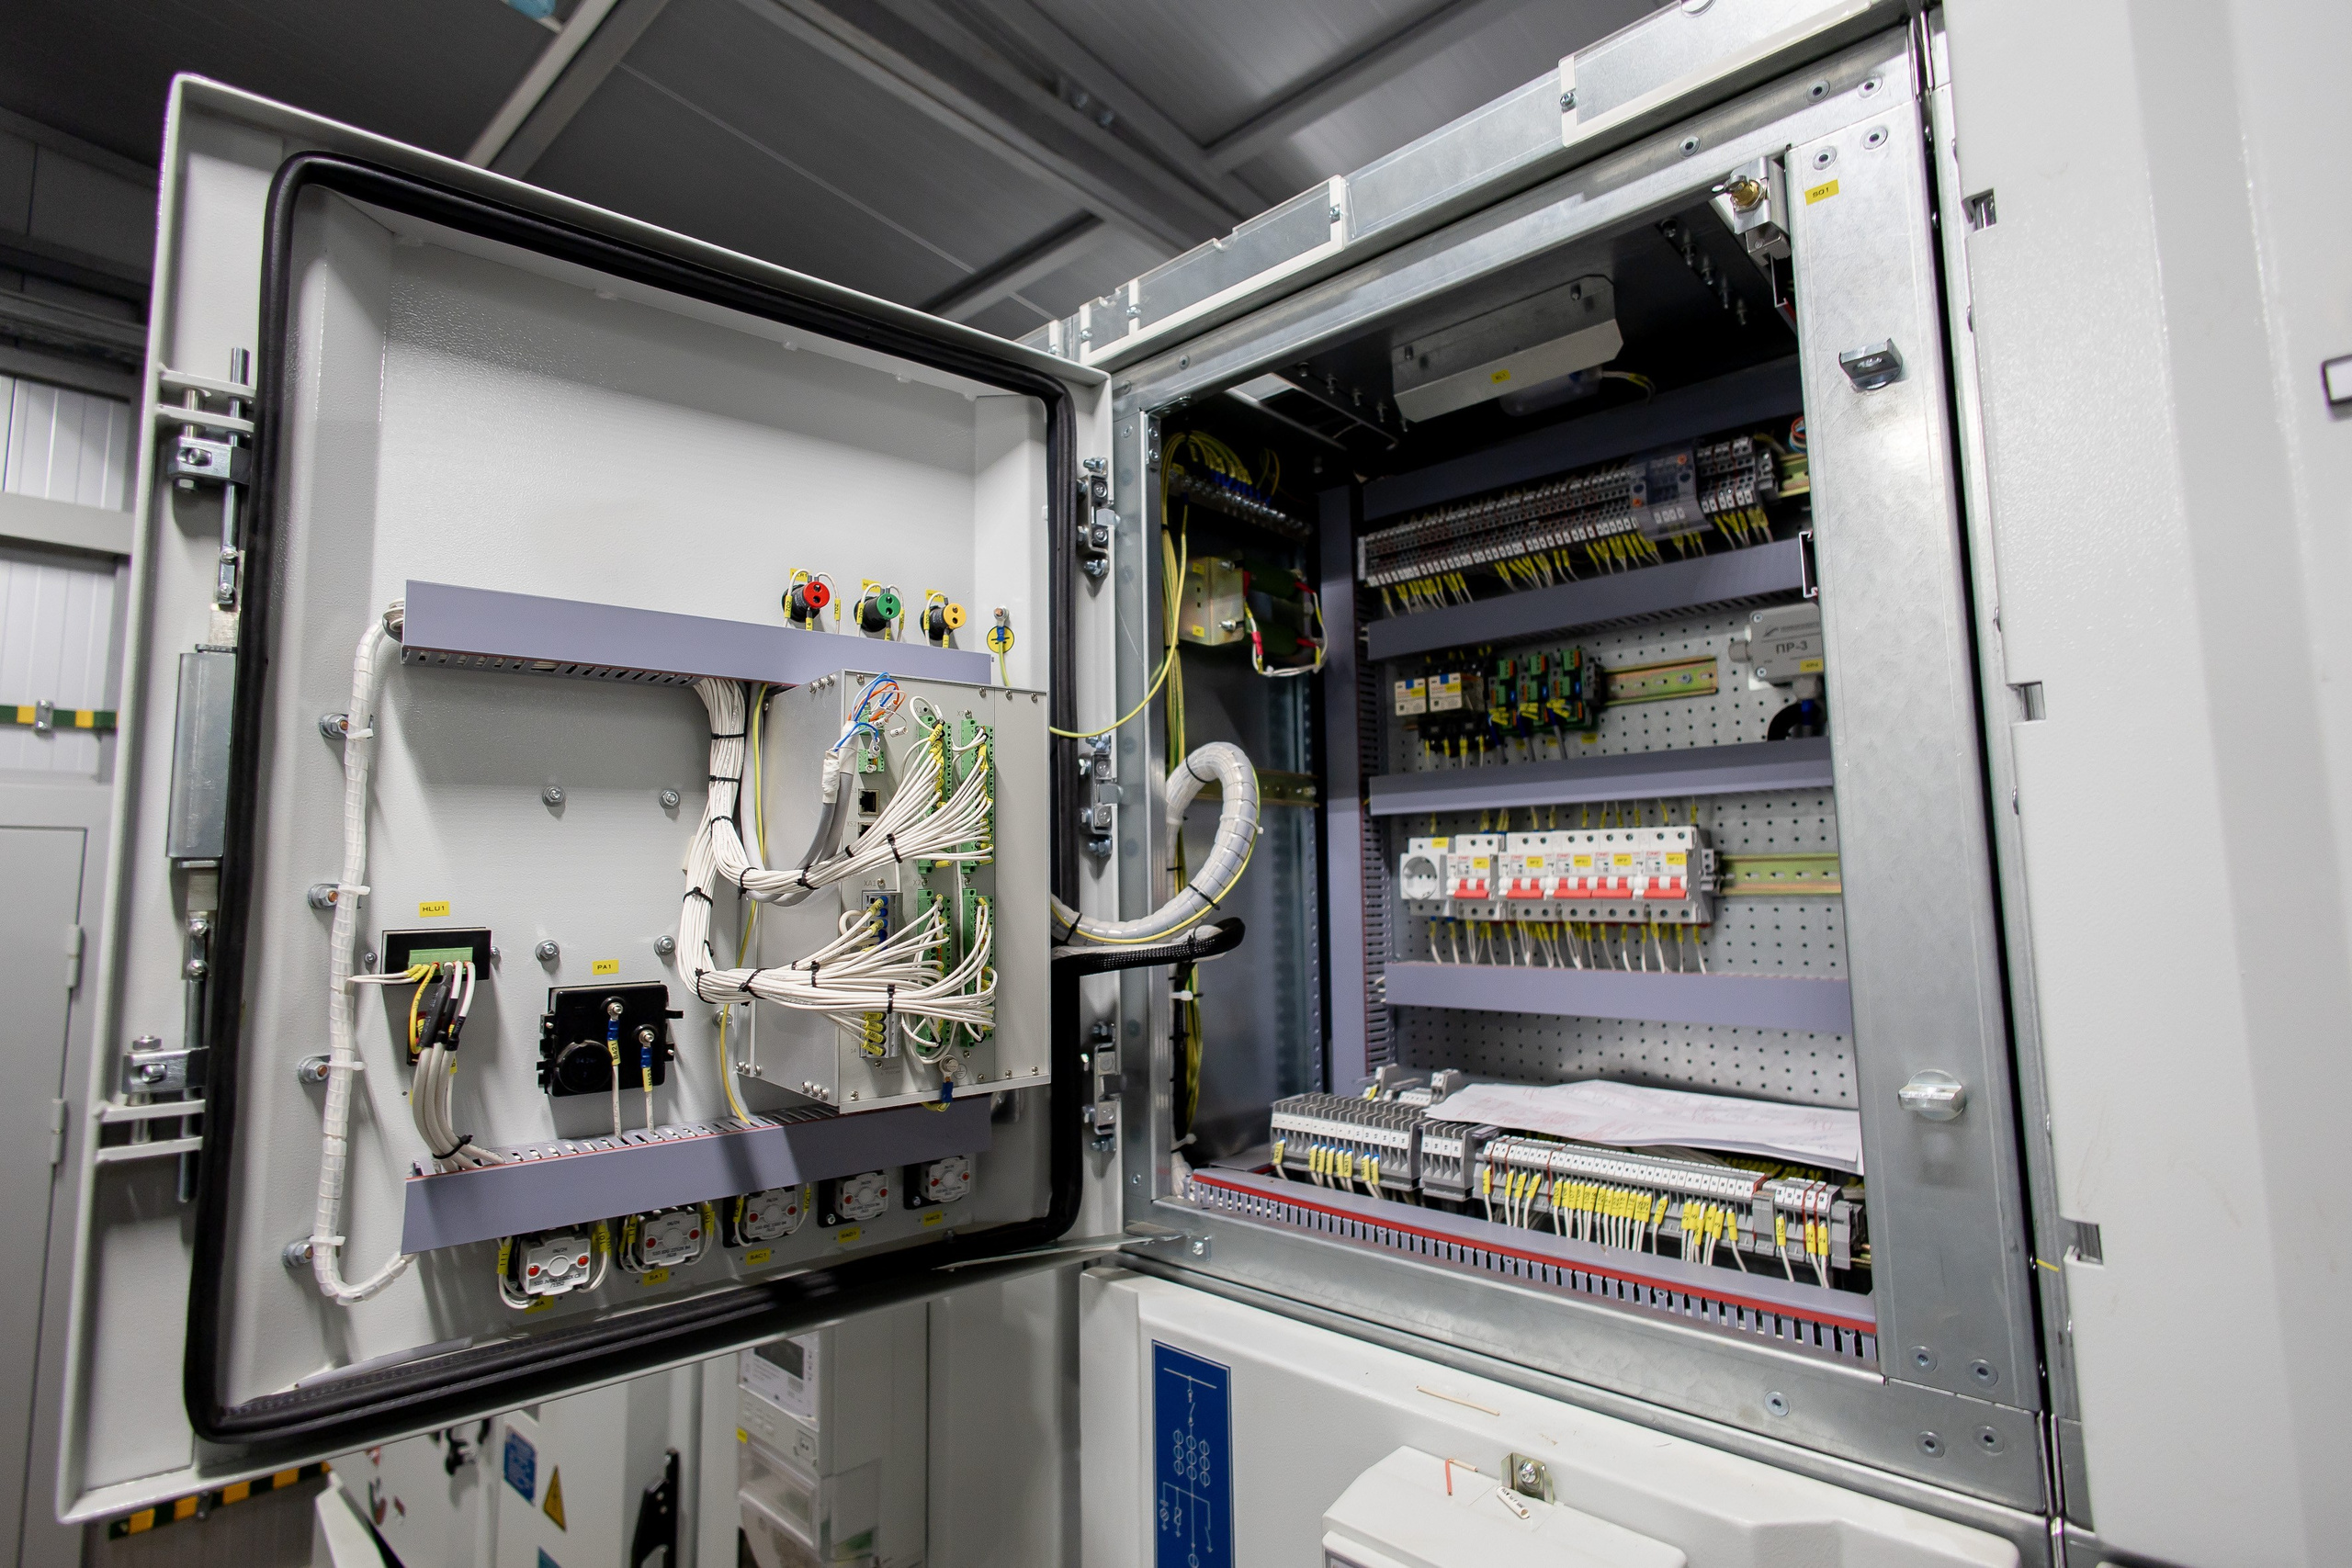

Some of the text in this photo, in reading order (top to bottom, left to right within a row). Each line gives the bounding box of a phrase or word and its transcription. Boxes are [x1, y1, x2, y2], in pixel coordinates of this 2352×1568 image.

[1776, 640, 1808, 655] ПР-3
[864, 879, 876, 887] XA1
[913, 879, 922, 887] X2
[610, 1042, 619, 1061] B421
[500, 1252, 508, 1266] 111
